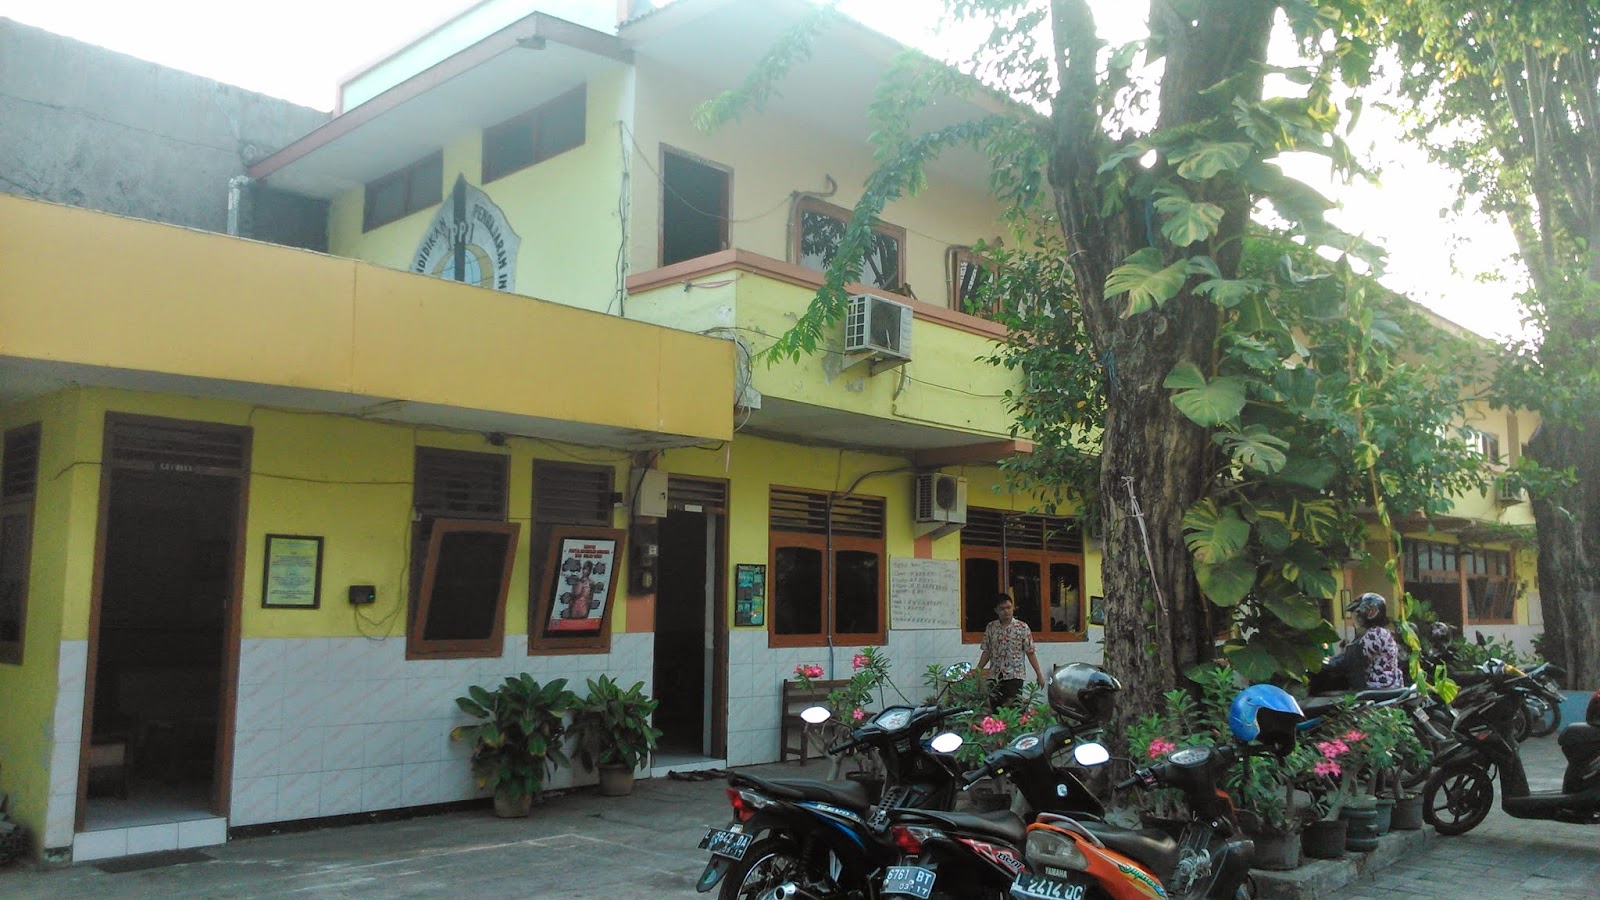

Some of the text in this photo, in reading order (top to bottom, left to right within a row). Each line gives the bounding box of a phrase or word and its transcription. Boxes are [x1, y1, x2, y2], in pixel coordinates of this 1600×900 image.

[887, 868, 932, 885] 6761 BT
[1044, 866, 1068, 879] YAMAHA
[1014, 873, 1023, 890] L
[1027, 878, 1063, 898] 2414
